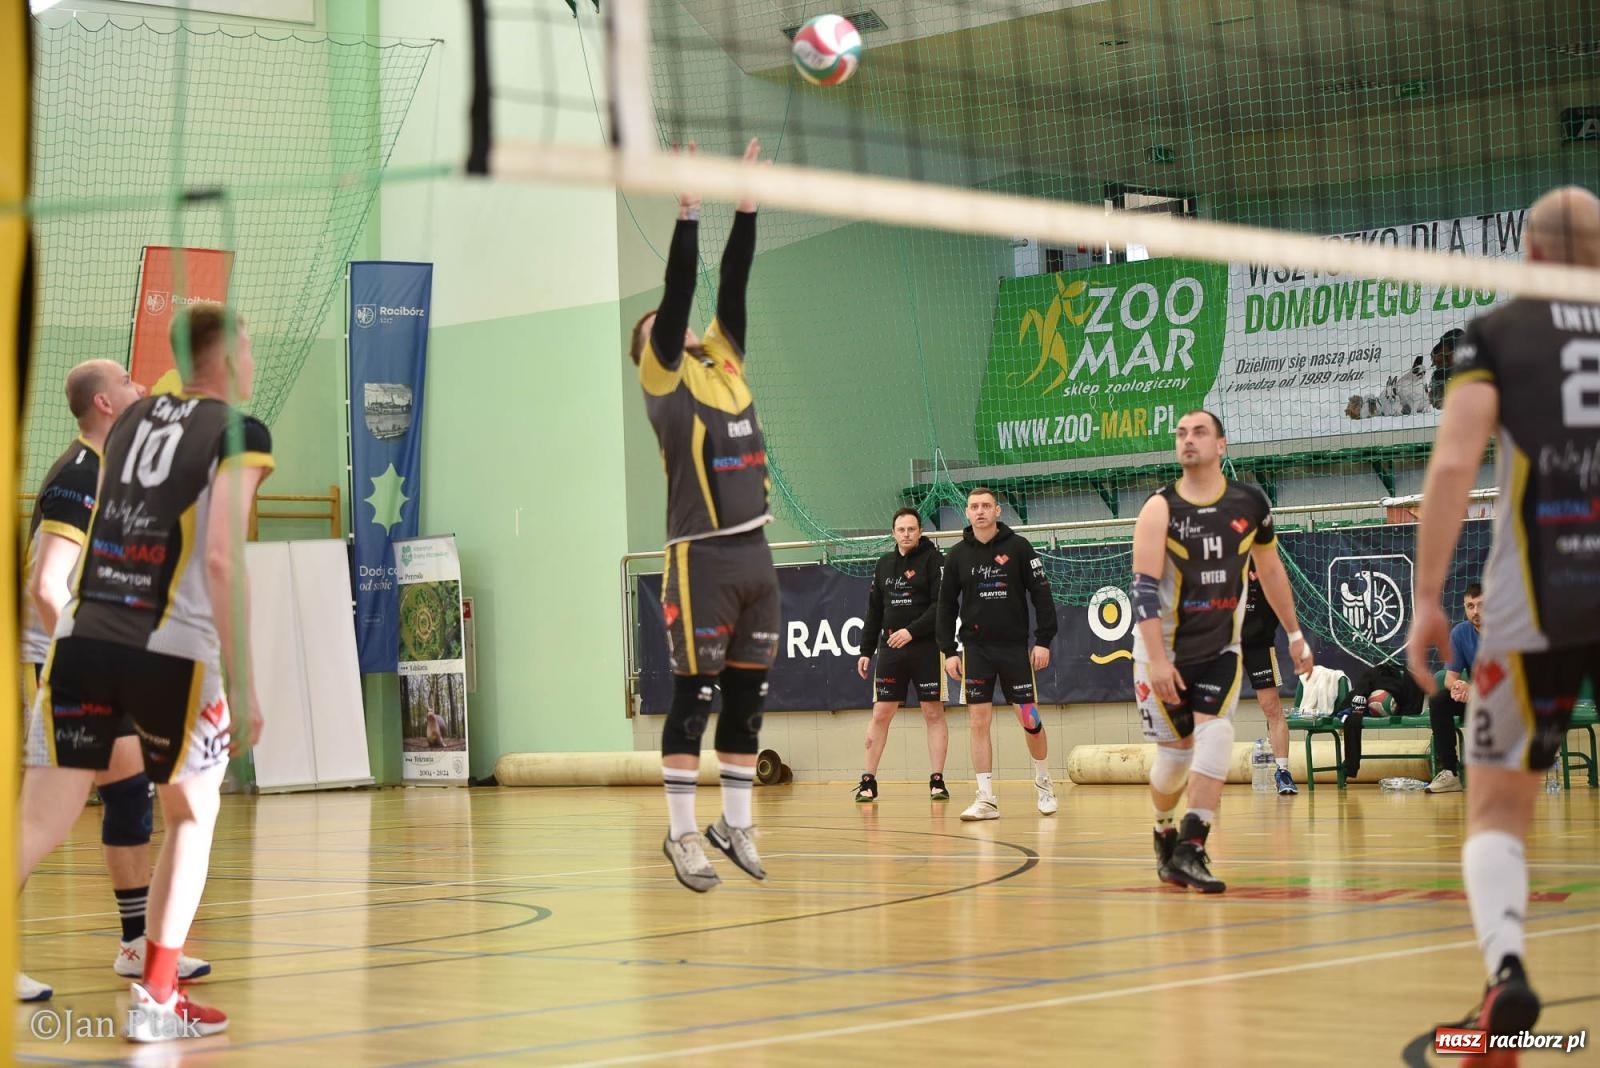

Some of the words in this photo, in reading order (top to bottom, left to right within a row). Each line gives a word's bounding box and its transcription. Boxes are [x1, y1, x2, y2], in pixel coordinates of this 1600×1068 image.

[1476, 209, 1525, 257] TW
[380, 306, 424, 317] Racibórz
[1084, 277, 1204, 334] ZOO
[1245, 279, 1421, 335] DOMOWEGO
[1067, 328, 1195, 381] MAR
[1236, 356, 1287, 375] Dzielimy
[1288, 353, 1307, 371] się
[1310, 350, 1345, 368] naszą
[1347, 344, 1382, 366] pasją
[1063, 382, 1100, 397] sklep
[1104, 376, 1190, 395] zoologiczny
[1226, 381, 1234, 393] i
[1235, 377, 1276, 392] wiedzą
[1278, 374, 1297, 388] od
[1299, 371, 1332, 386] 1989
[1333, 368, 1365, 382] roku.
[121, 419, 184, 488] 10
[1202, 536, 1223, 560] 14
[1201, 570, 1227, 585] ENTER
[1475, 708, 1493, 748] 2
